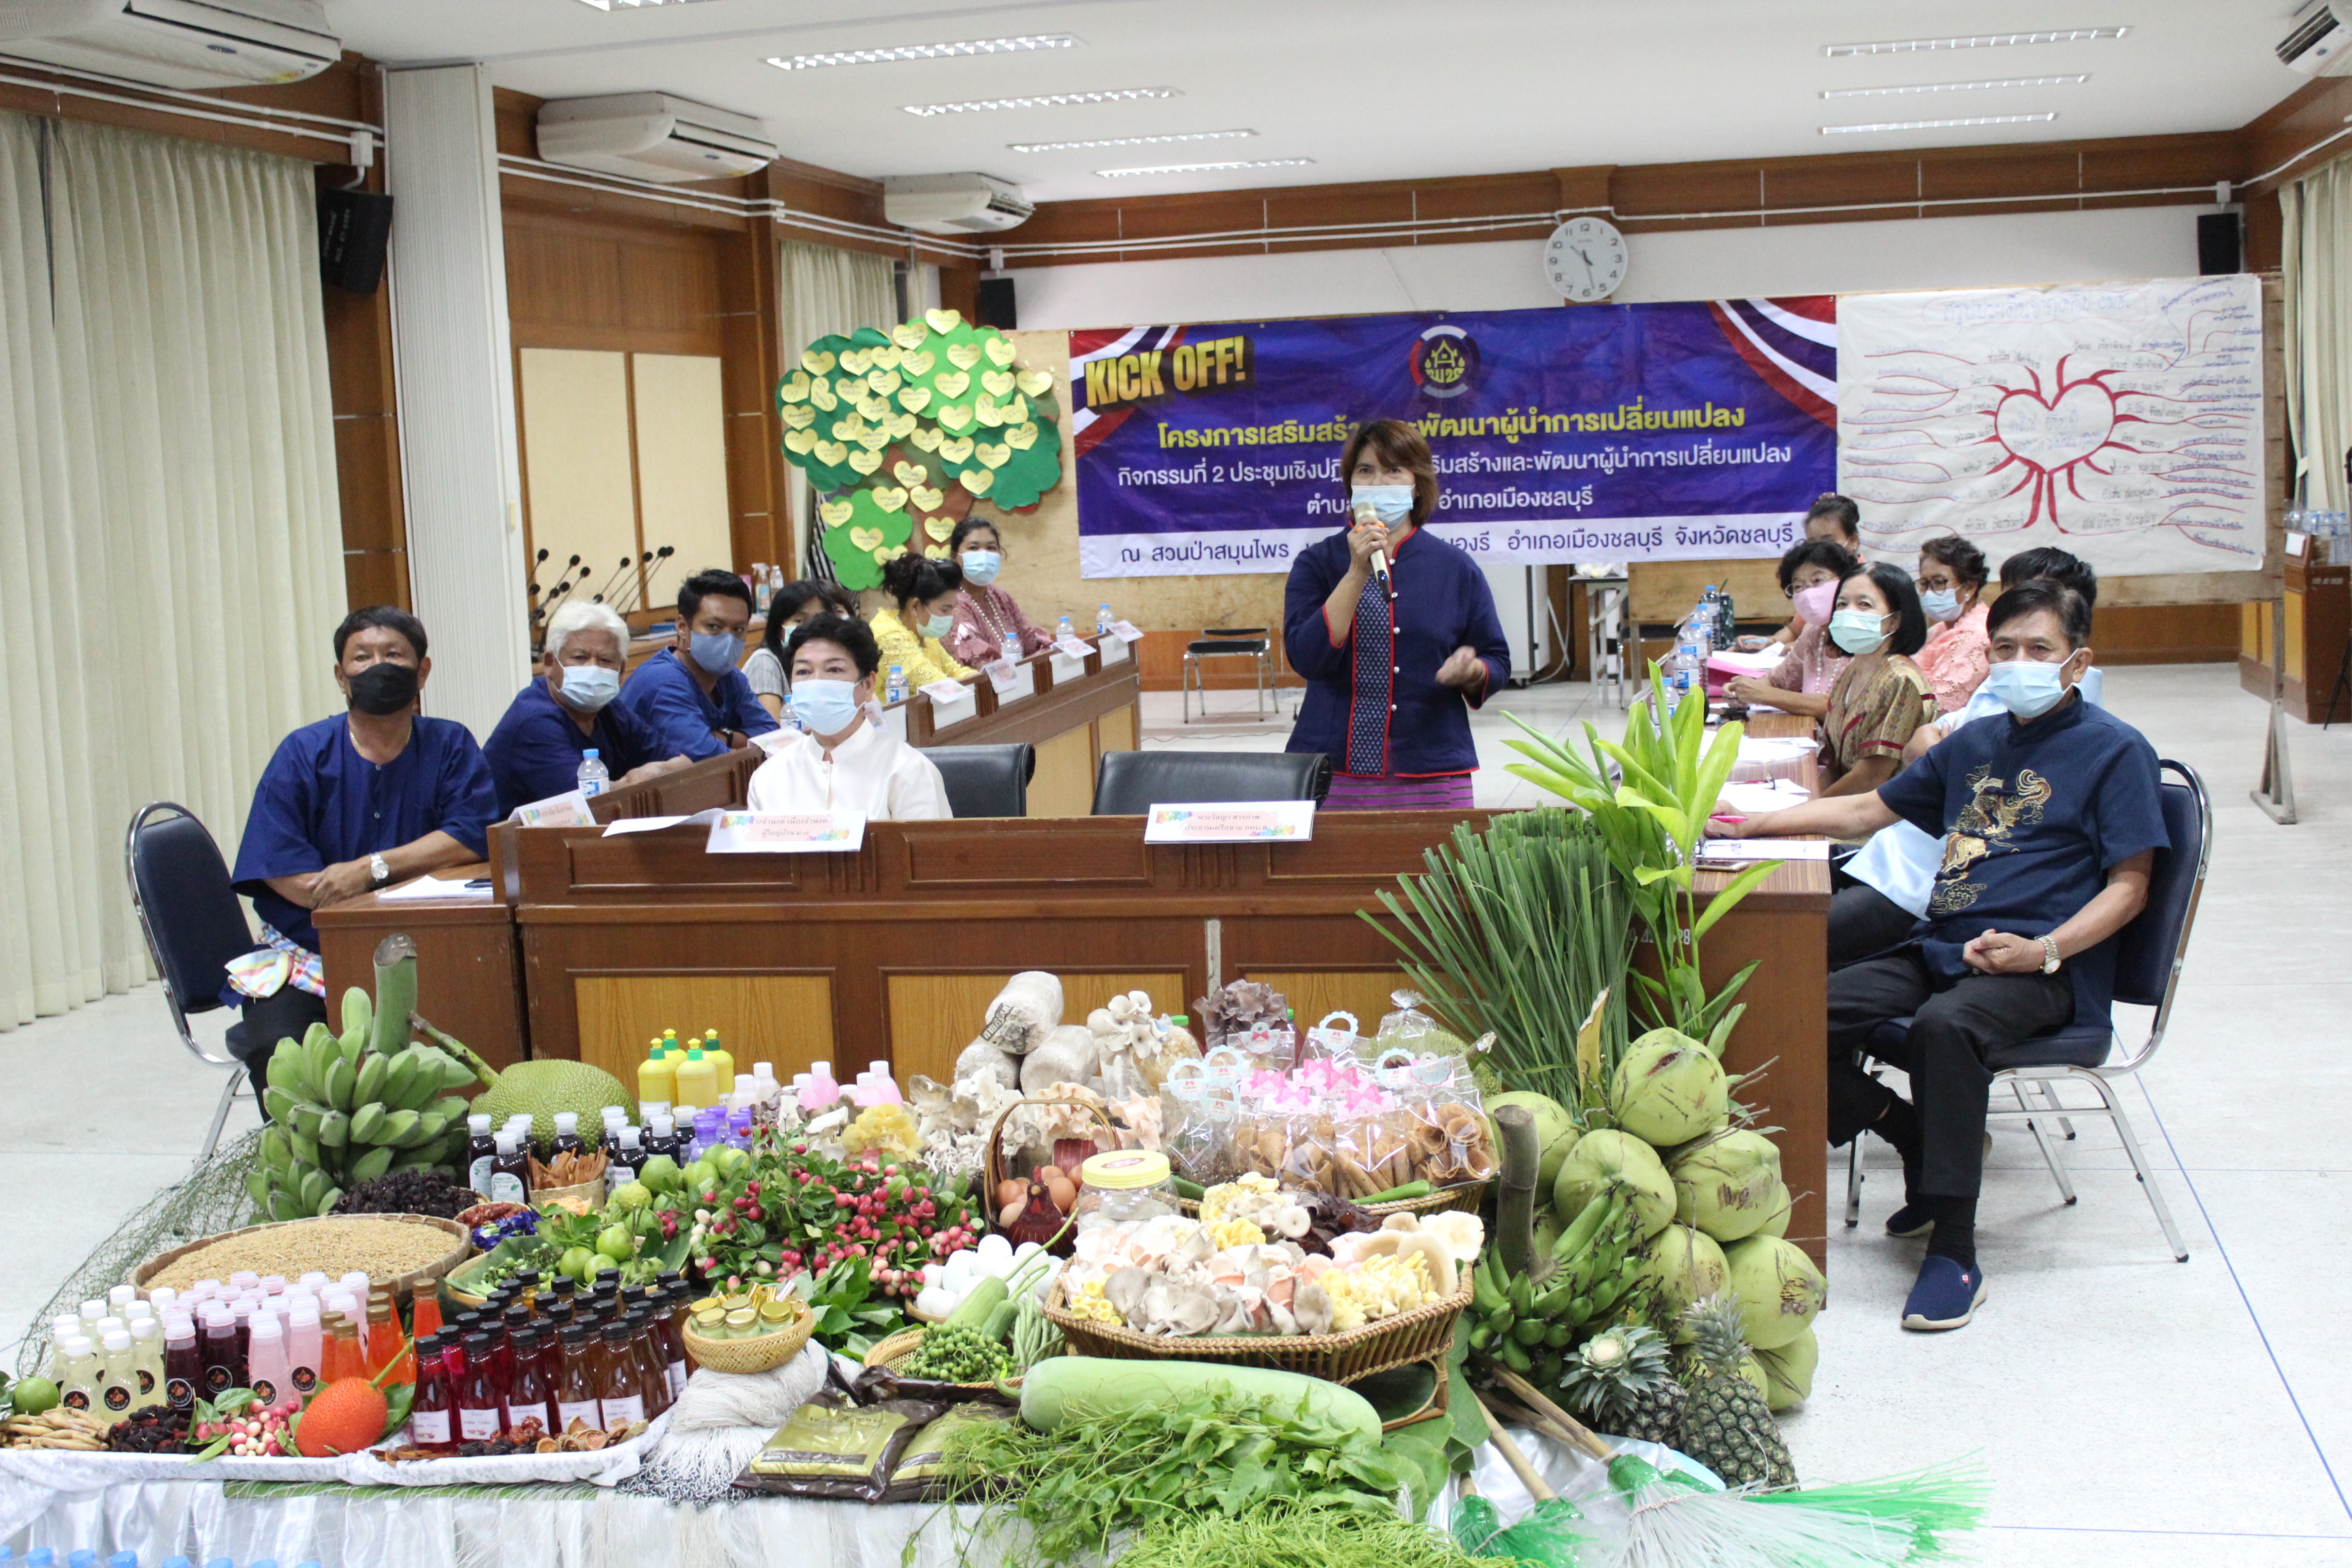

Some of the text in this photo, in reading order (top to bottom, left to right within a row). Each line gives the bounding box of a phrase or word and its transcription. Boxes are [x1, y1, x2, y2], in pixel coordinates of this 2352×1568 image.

[1580, 223, 1590, 232] 12
[1565, 228, 1573, 236] 11
[1552, 241, 1563, 249] 10
[1611, 238, 1618, 246] 2
[1550, 257, 1558, 265] 9
[1614, 255, 1622, 263] 3
[1554, 273, 1562, 282] 8
[1610, 270, 1617, 278] 4
[1566, 285, 1573, 293] 7
[1599, 283, 1607, 292] 5
[1582, 289, 1590, 297] 6
[1085, 335, 1246, 408] KICK OFF!
[1118, 458, 1207, 487] กิจกรรมที่
[1213, 466, 1224, 483] 2
[1438, 484, 1593, 512] อำเภอเมืองชลบุรี
[1122, 521, 1793, 568] ณ สวนป่าสมุนไพร องรี อำเภอเมืองชลบุรี จังหวัดชลบุรี
